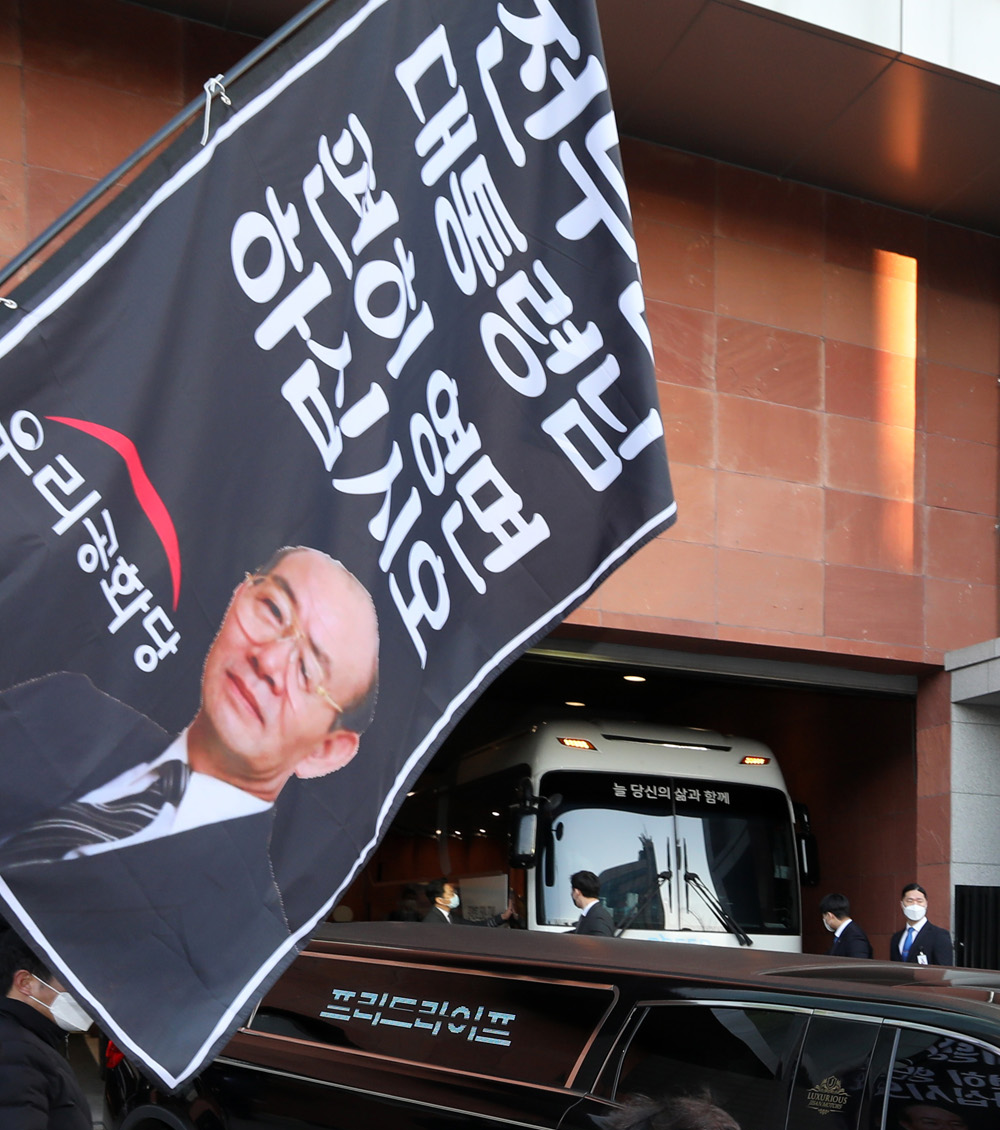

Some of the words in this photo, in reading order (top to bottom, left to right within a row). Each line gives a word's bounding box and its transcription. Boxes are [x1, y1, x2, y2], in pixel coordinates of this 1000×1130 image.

[395, 23, 663, 491] 대통령님
[475, 0, 655, 366] 전두
[229, 186, 451, 668] 하십시오
[302, 113, 434, 379] 편히
[409, 369, 550, 594] 영면
[0, 410, 181, 672] 우리공화당
[613, 782, 627, 797] 늘
[630, 784, 671, 799] 당신의
[674, 787, 701, 802] 삶과
[704, 790, 730, 805] 함께
[319, 988, 517, 1047] 프리드라이프
[807, 1091, 849, 1105] LUXURIOUS
